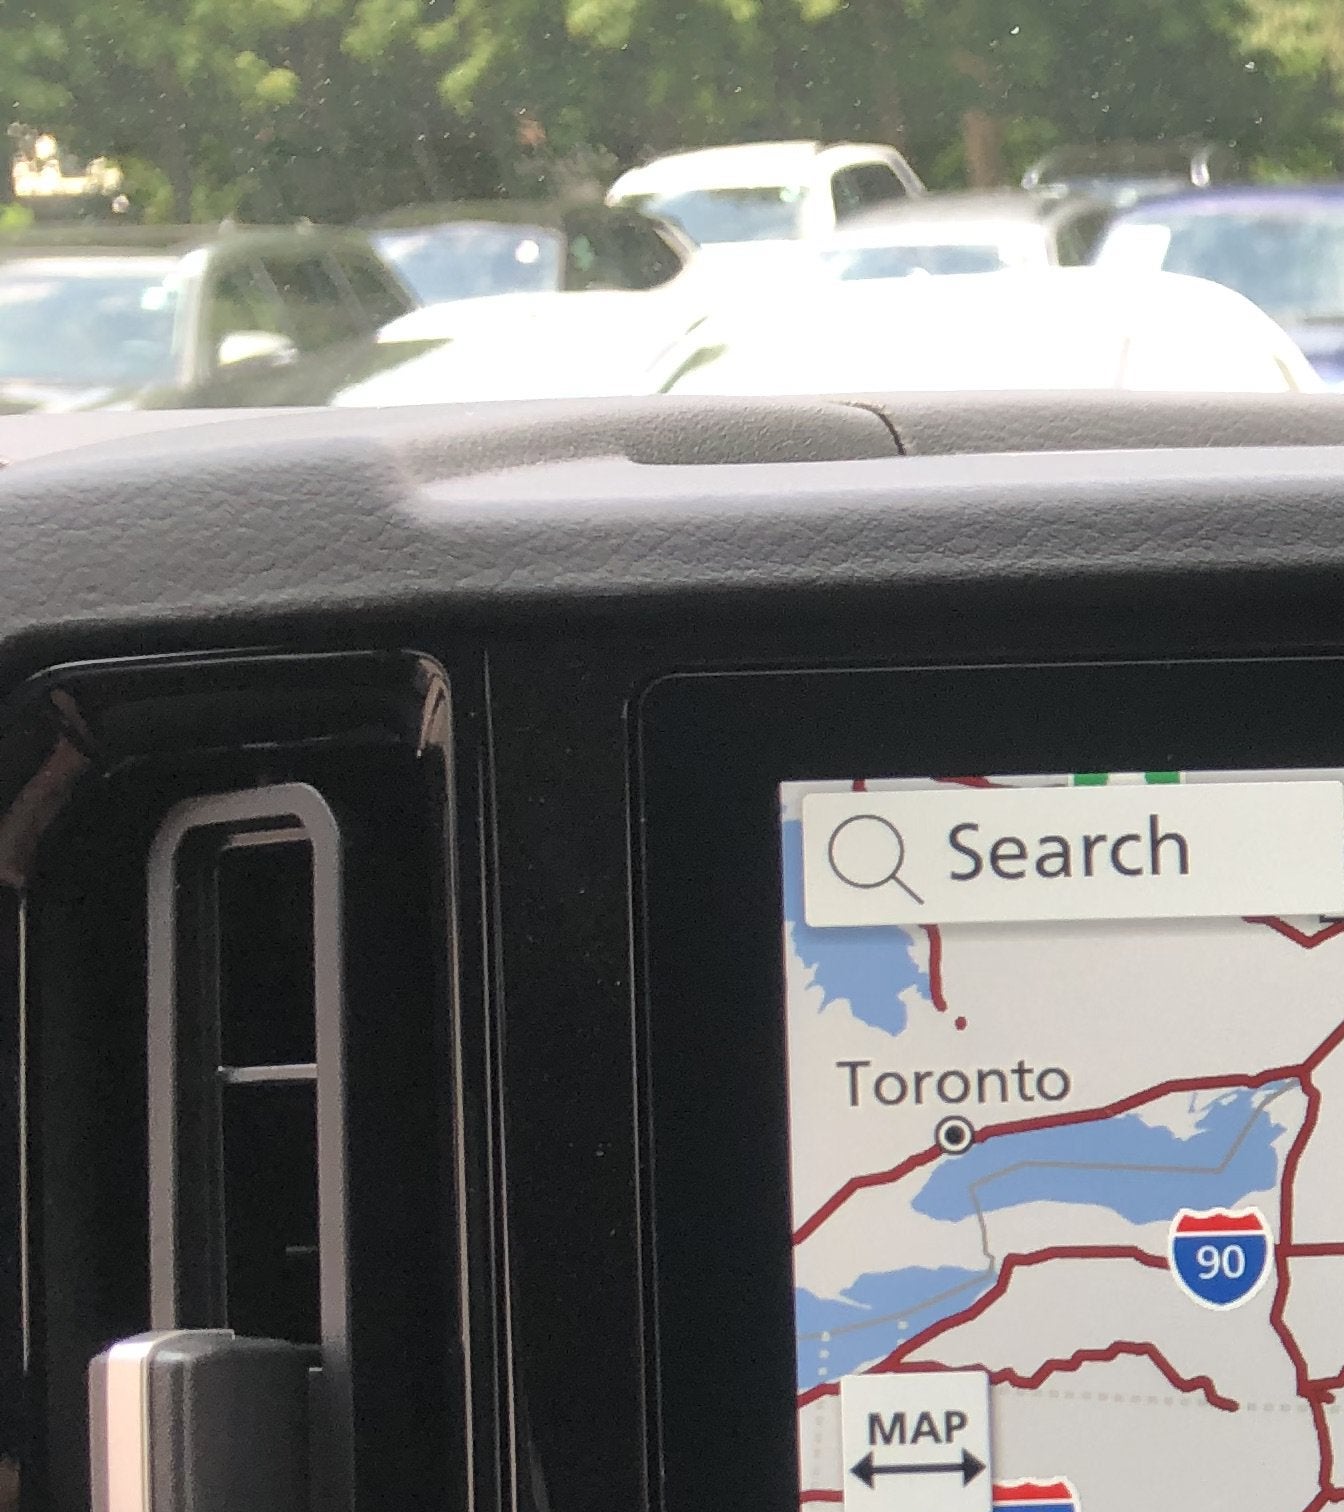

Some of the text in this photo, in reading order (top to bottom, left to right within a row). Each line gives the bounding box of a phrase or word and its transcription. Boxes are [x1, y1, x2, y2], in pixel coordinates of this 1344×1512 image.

[948, 813, 1191, 882] Search
[836, 1058, 1071, 1107] Toronto
[1196, 1244, 1246, 1278] 90
[867, 1411, 969, 1446] MAP
